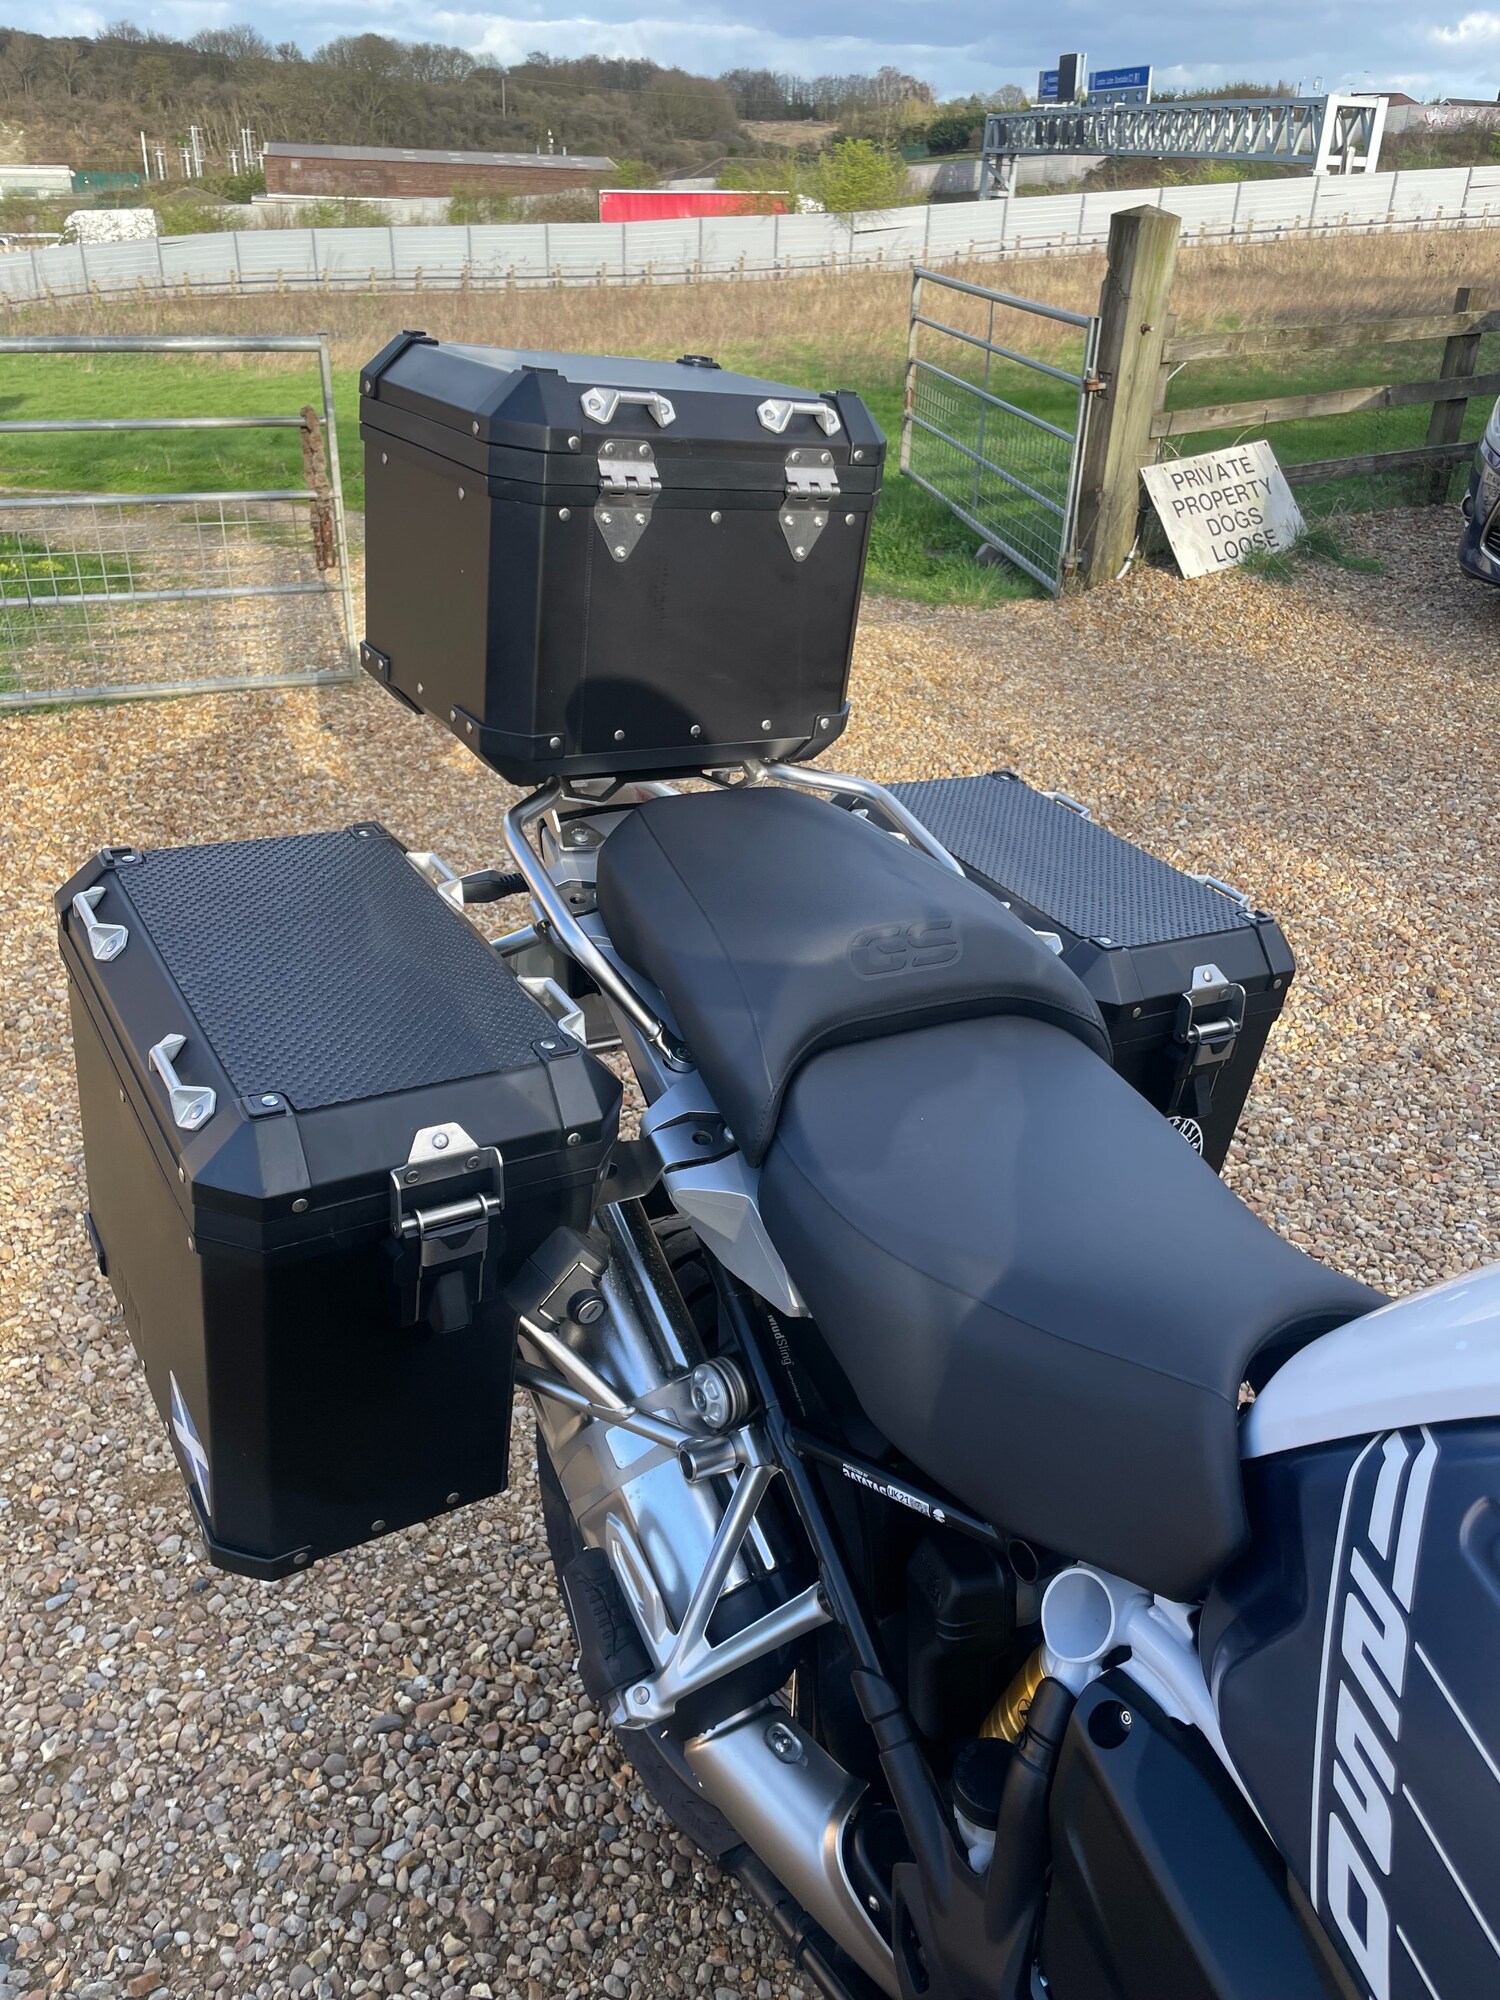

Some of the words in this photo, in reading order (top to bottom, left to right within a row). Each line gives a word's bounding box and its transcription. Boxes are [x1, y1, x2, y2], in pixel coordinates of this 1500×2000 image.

[1170, 457, 1255, 491] PRIVATE
[1172, 477, 1272, 518] PROPERTY
[1206, 507, 1263, 536] DOGS
[1211, 529, 1279, 563] LOOSE
[851, 919, 959, 976] GS
